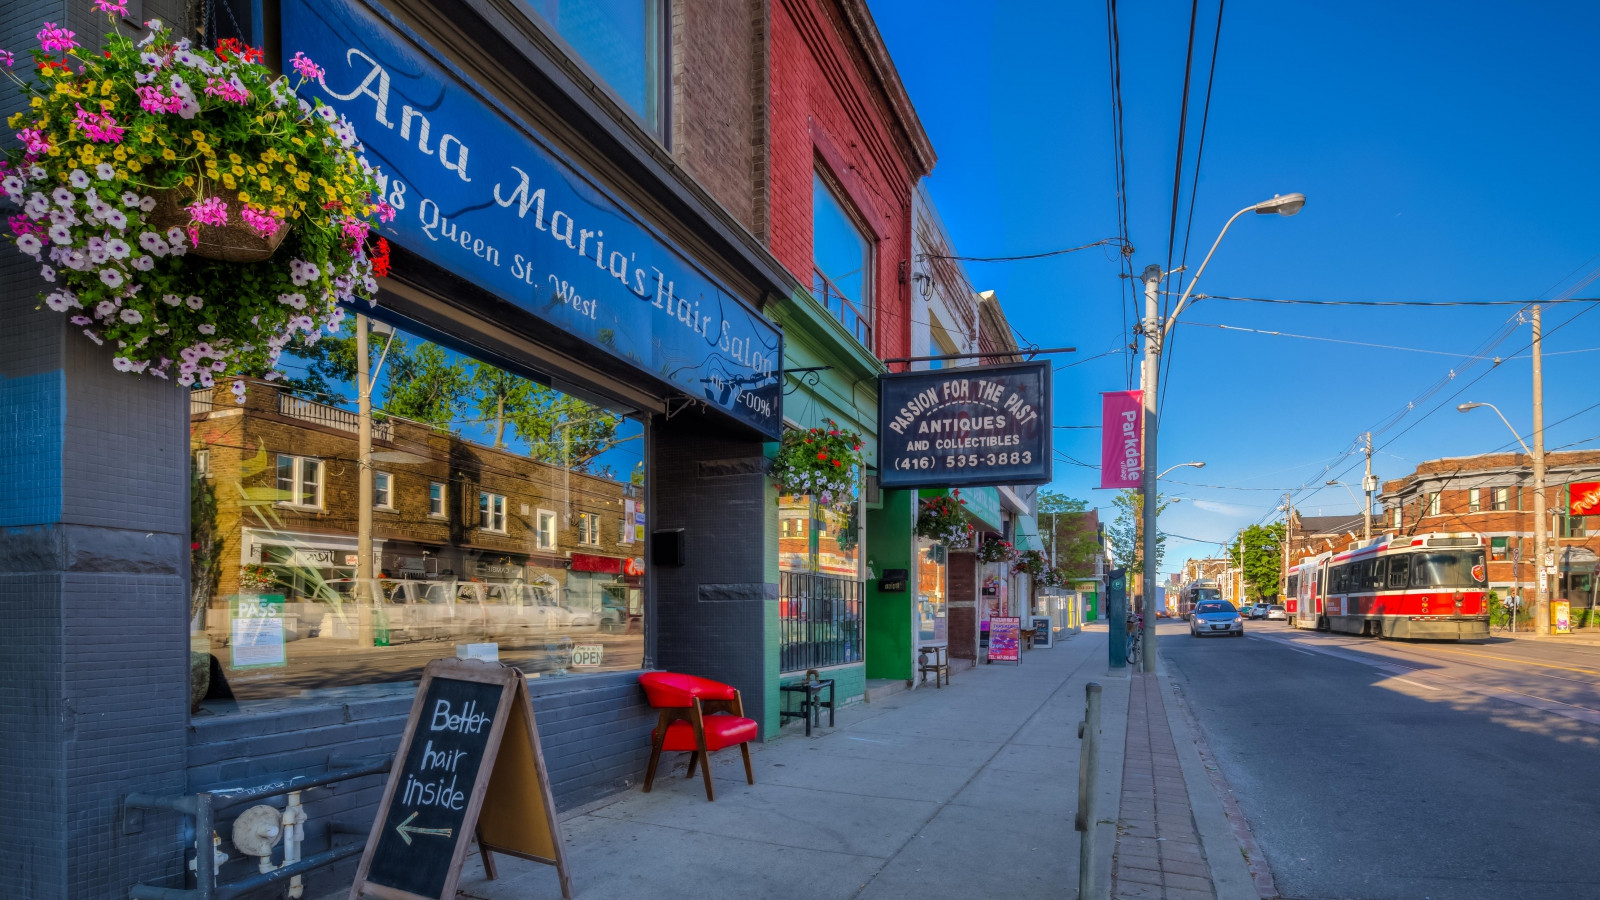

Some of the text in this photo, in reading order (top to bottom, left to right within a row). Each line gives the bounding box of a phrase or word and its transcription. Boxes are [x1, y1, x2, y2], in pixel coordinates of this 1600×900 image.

[318, 48, 773, 378] Ana Maria's Hair Salon
[419, 198, 501, 267] Queen
[511, 254, 538, 288] St.
[549, 274, 597, 320] West
[889, 379, 1038, 435] PASSION FOR THE PAST
[918, 415, 1007, 434] ANTIQUES
[906, 434, 1020, 452] AND COLLECTIBLES
[1121, 410, 1141, 481] Parkdale
[894, 451, 1032, 471] (416) 535-3883
[239, 602, 277, 618] PASS
[573, 651, 603, 665] OPEN
[430, 699, 491, 734] Better
[420, 740, 468, 773] hair
[402, 774, 465, 811] inside
